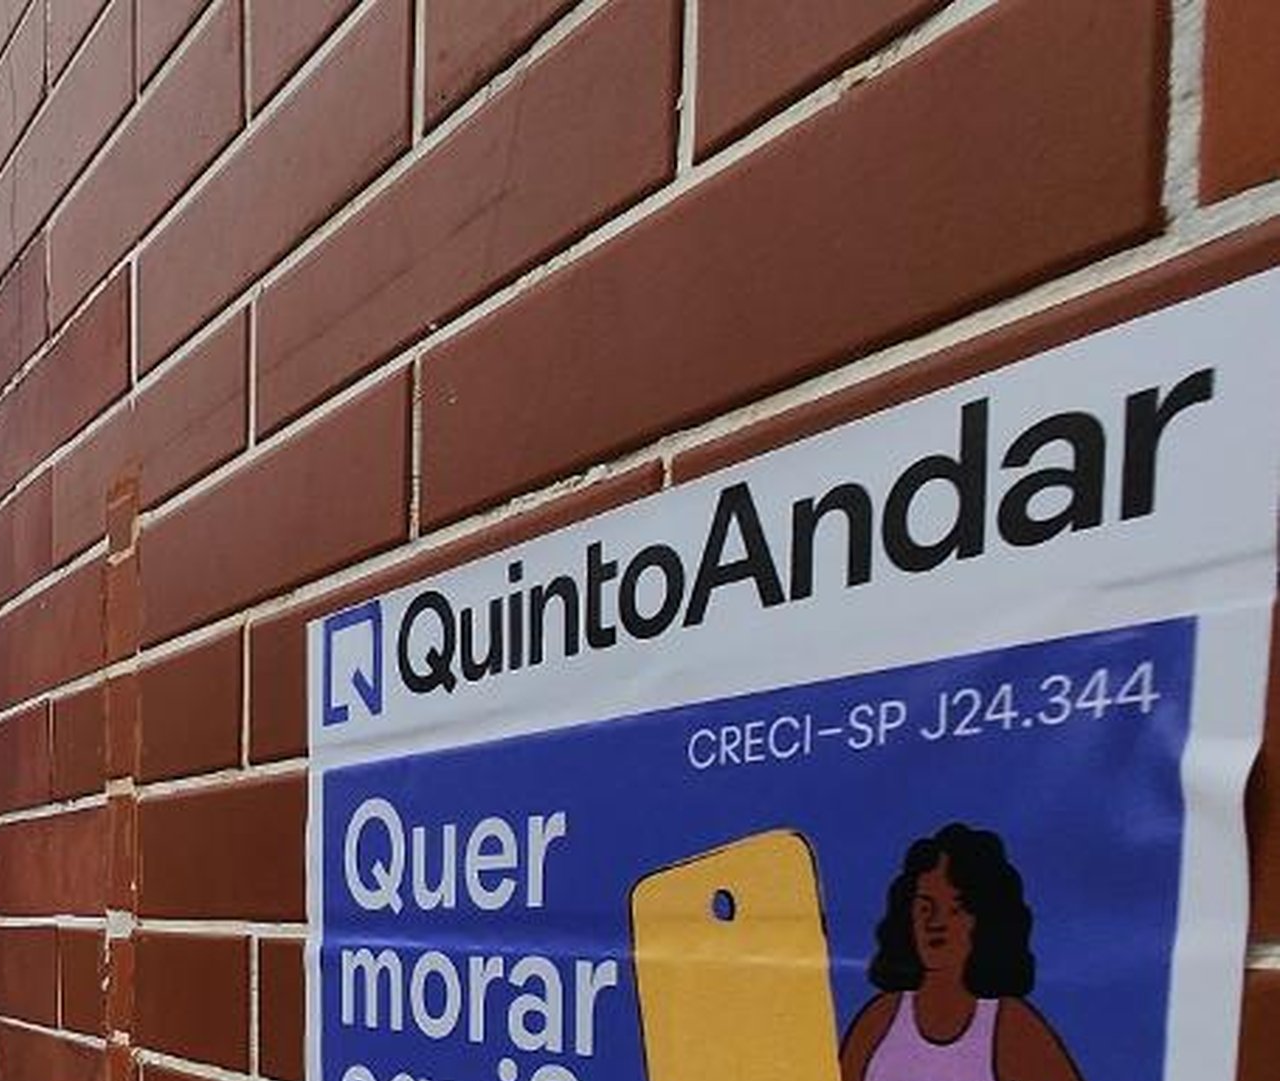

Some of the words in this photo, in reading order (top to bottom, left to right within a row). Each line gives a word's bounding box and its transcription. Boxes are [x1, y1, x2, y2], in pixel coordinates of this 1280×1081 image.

[397, 367, 1215, 694] QuintoAndar
[688, 702, 908, 770] CRECI-SP
[920, 661, 1162, 742] J24.344
[344, 798, 566, 914] Quer
[341, 947, 617, 1056] morar
